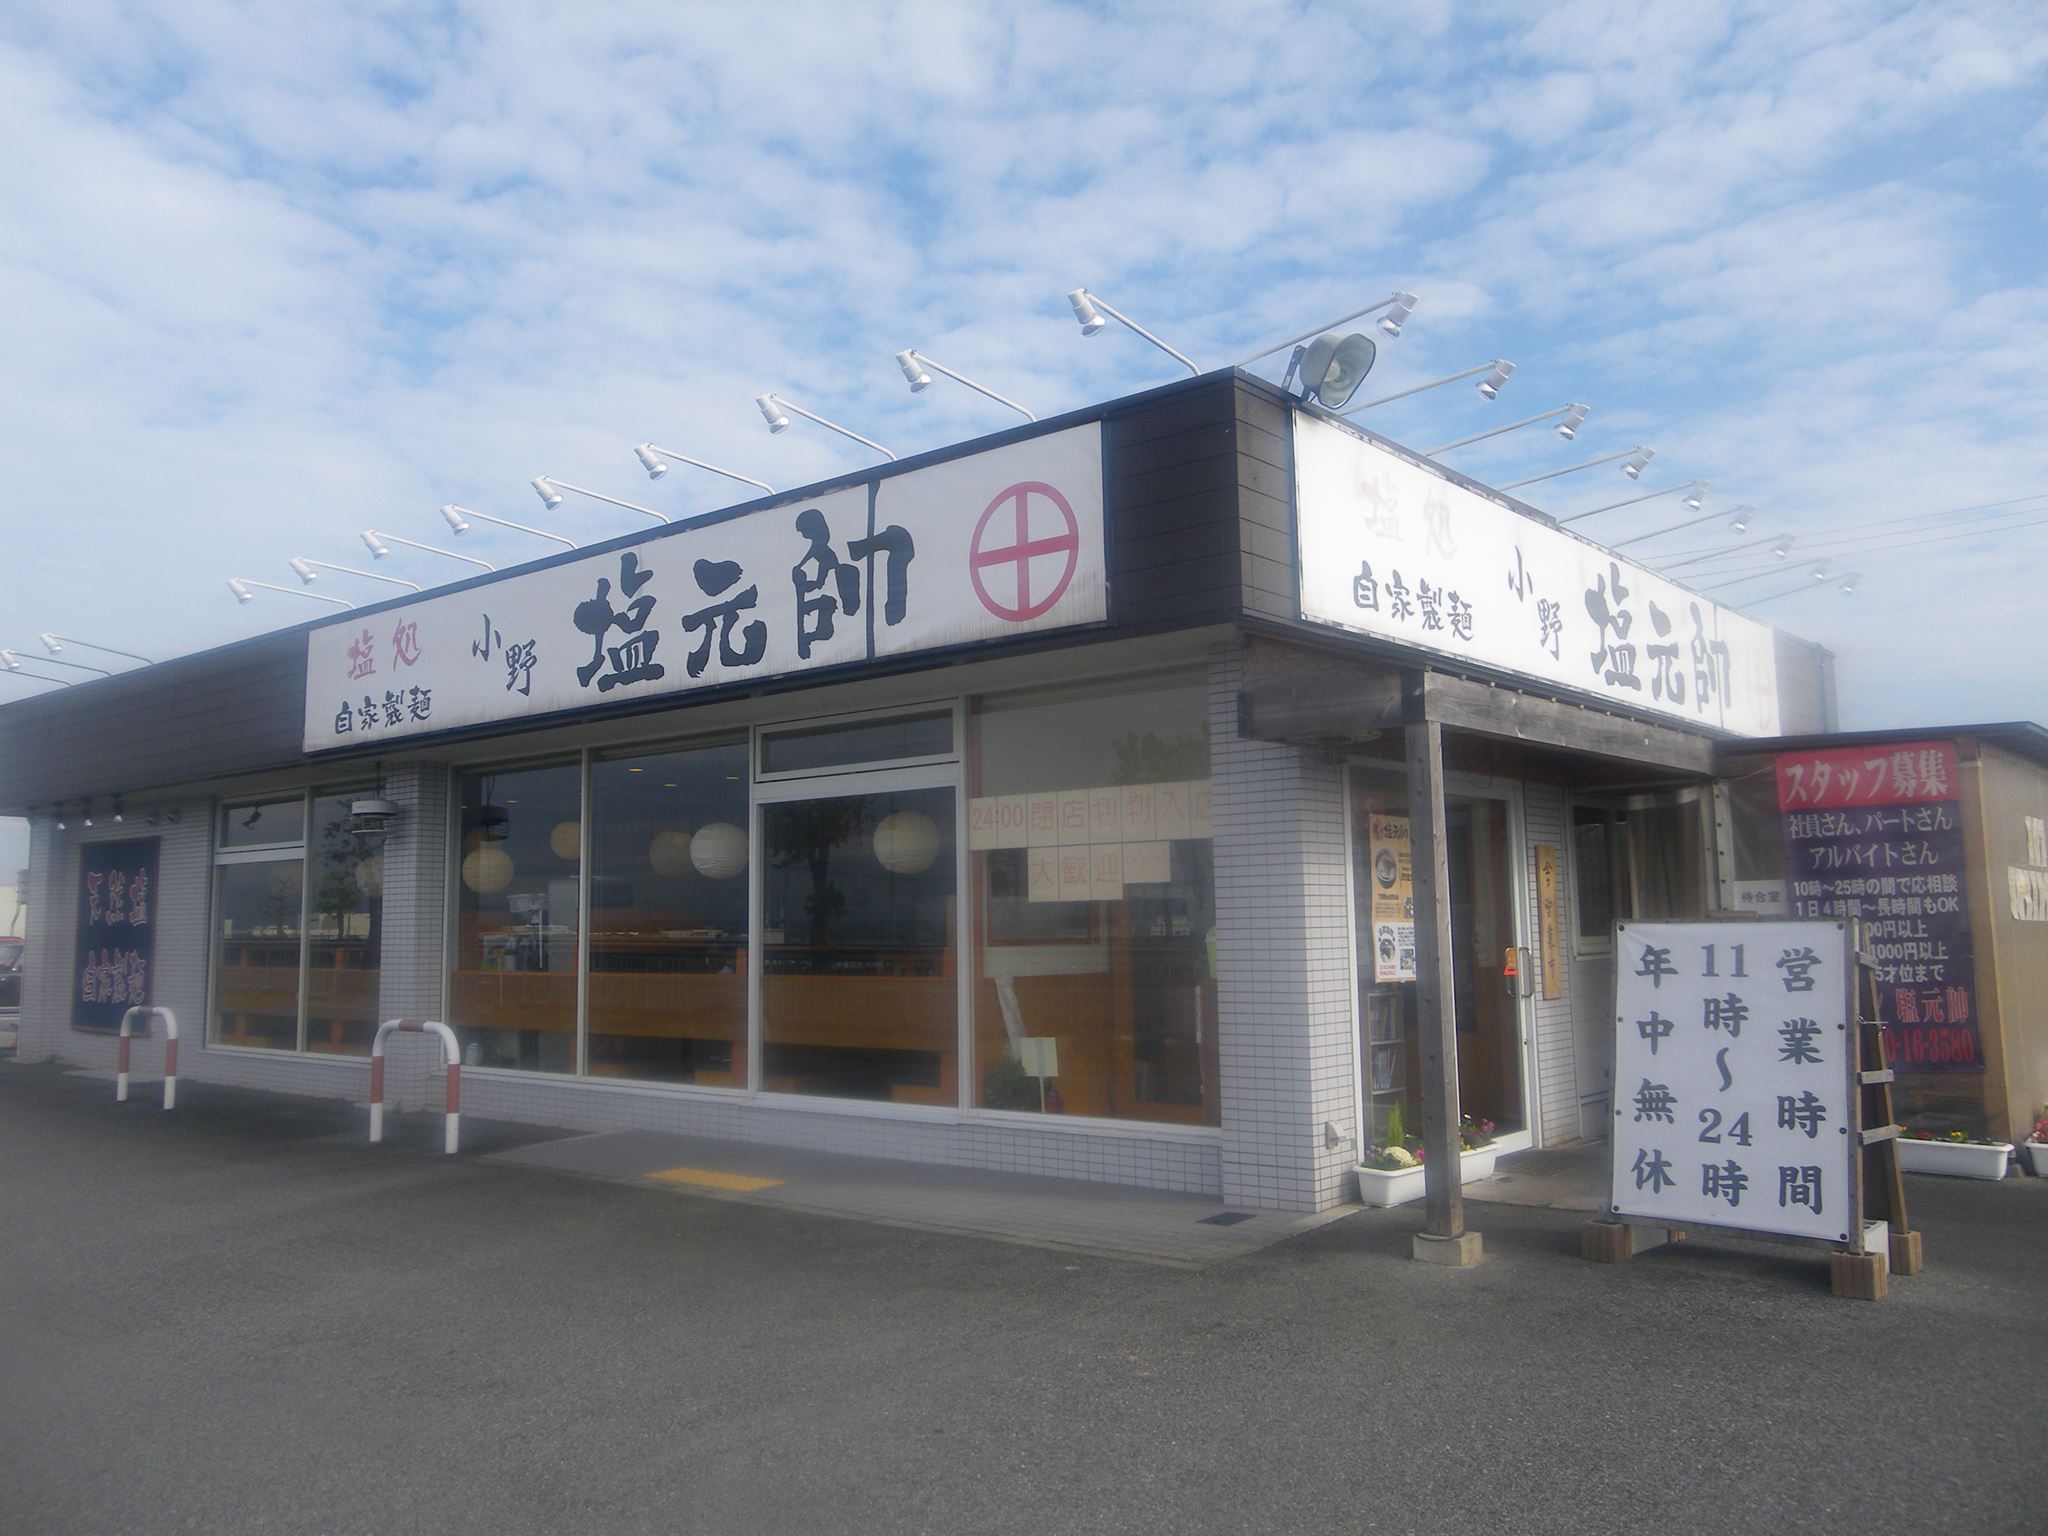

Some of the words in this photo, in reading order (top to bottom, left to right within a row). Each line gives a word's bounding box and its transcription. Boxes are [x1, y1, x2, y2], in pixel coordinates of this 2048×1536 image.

[573, 479, 915, 692] 塩元帥
[1353, 560, 1473, 641] 自家製麺
[1508, 545, 1561, 661] 小野
[347, 618, 422, 680] 塩処
[471, 613, 535, 695] 小野
[1585, 562, 1731, 728] 塩元帥
[334, 685, 432, 735] 自家製麺
[1785, 749, 1948, 803] スタッフ募集
[1789, 807, 1953, 839] 社員さん、パートさん
[1809, 841, 1938, 869] アルバイトさん
[1631, 944, 1678, 1194] 年中無休
[1776, 947, 1826, 1215] 営業時間
